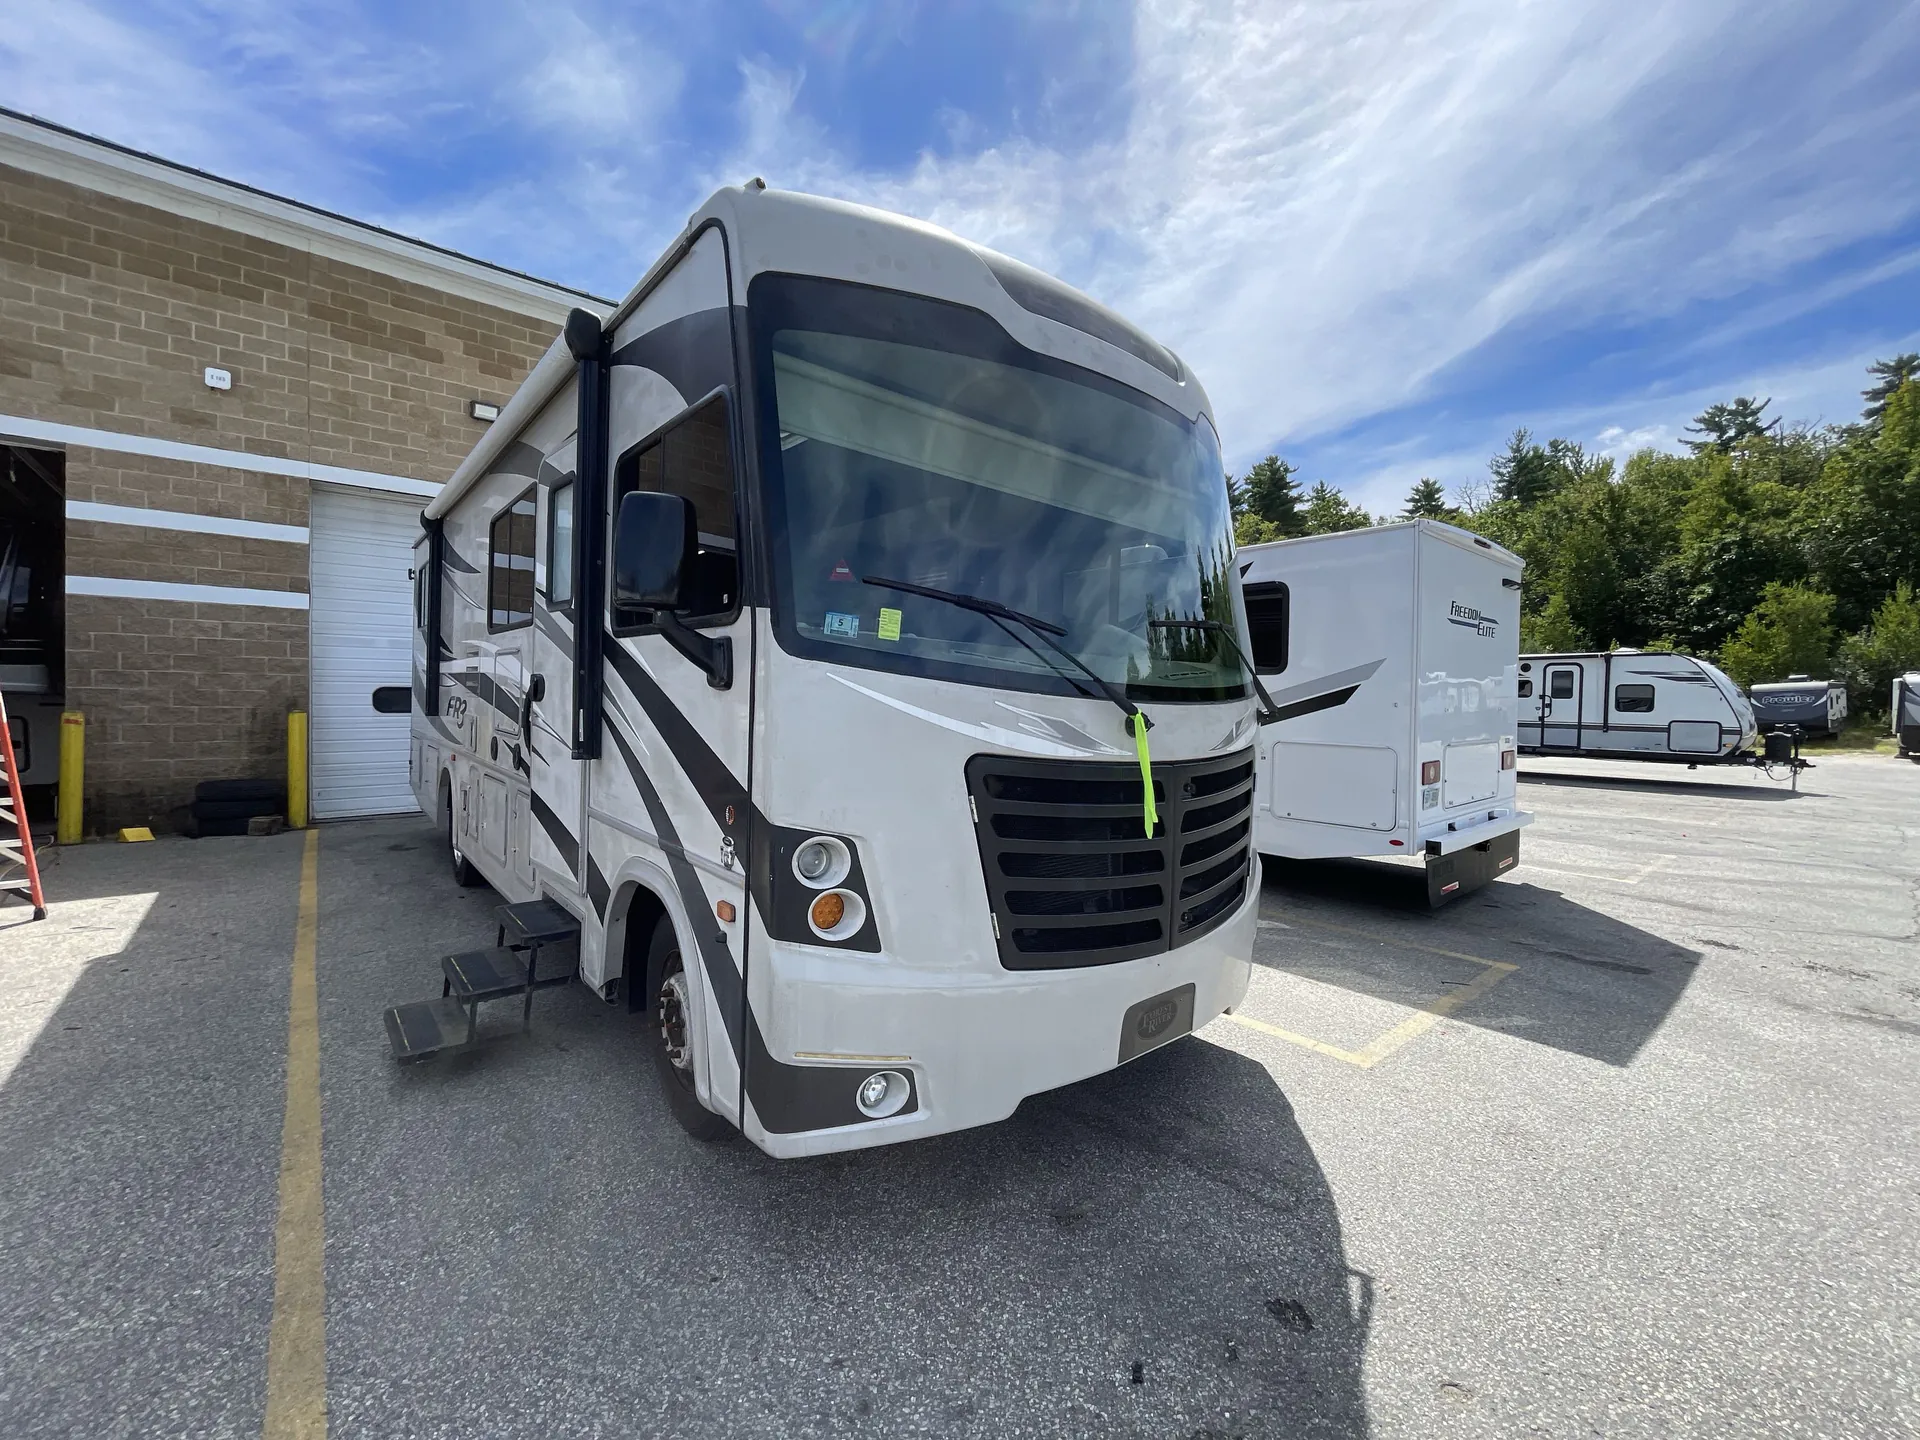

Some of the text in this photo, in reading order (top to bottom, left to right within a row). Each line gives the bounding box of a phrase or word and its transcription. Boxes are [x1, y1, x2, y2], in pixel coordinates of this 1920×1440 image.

[1450, 600, 1481, 621] FREEDOM
[1477, 621, 1496, 639] ELITE
[1761, 695, 1815, 704] Prowler
[446, 695, 467, 729] FR3
[1142, 1002, 1172, 1027] FOREST
[1148, 1012, 1172, 1033] RIVER
